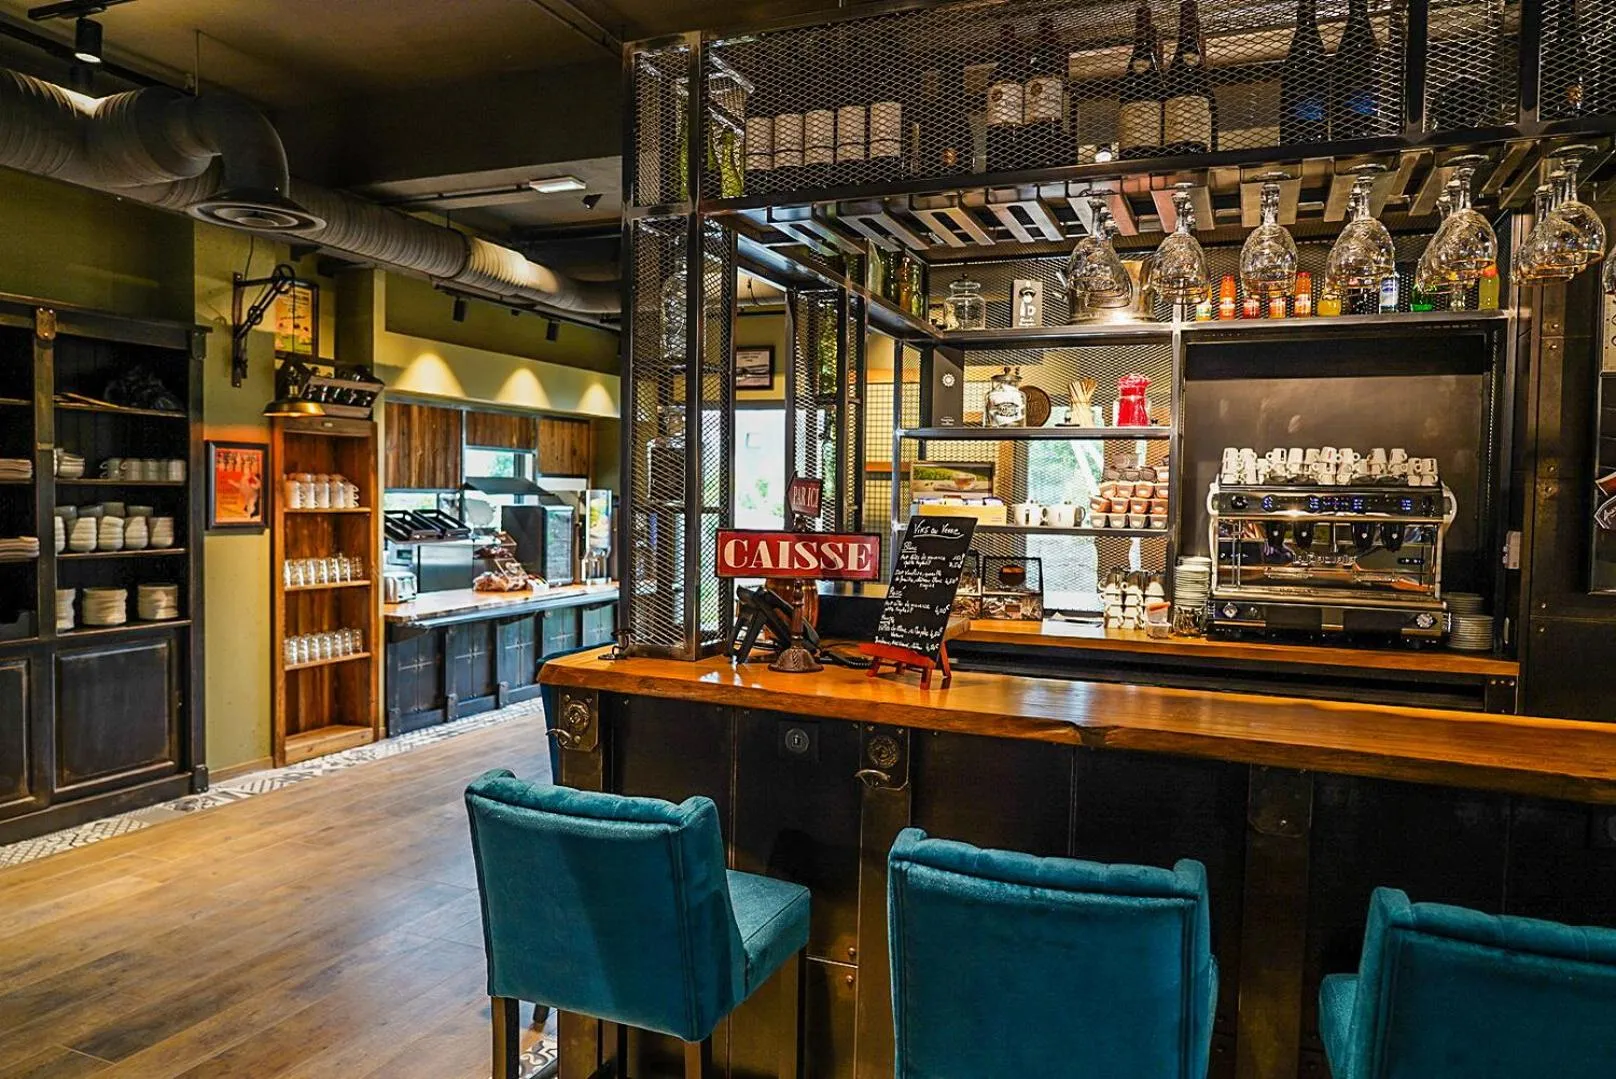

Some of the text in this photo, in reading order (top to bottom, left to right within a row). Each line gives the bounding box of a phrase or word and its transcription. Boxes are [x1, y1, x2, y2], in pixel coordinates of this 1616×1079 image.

[793, 486, 820, 508] PAR ICI
[724, 538, 871, 571] CAISSE
